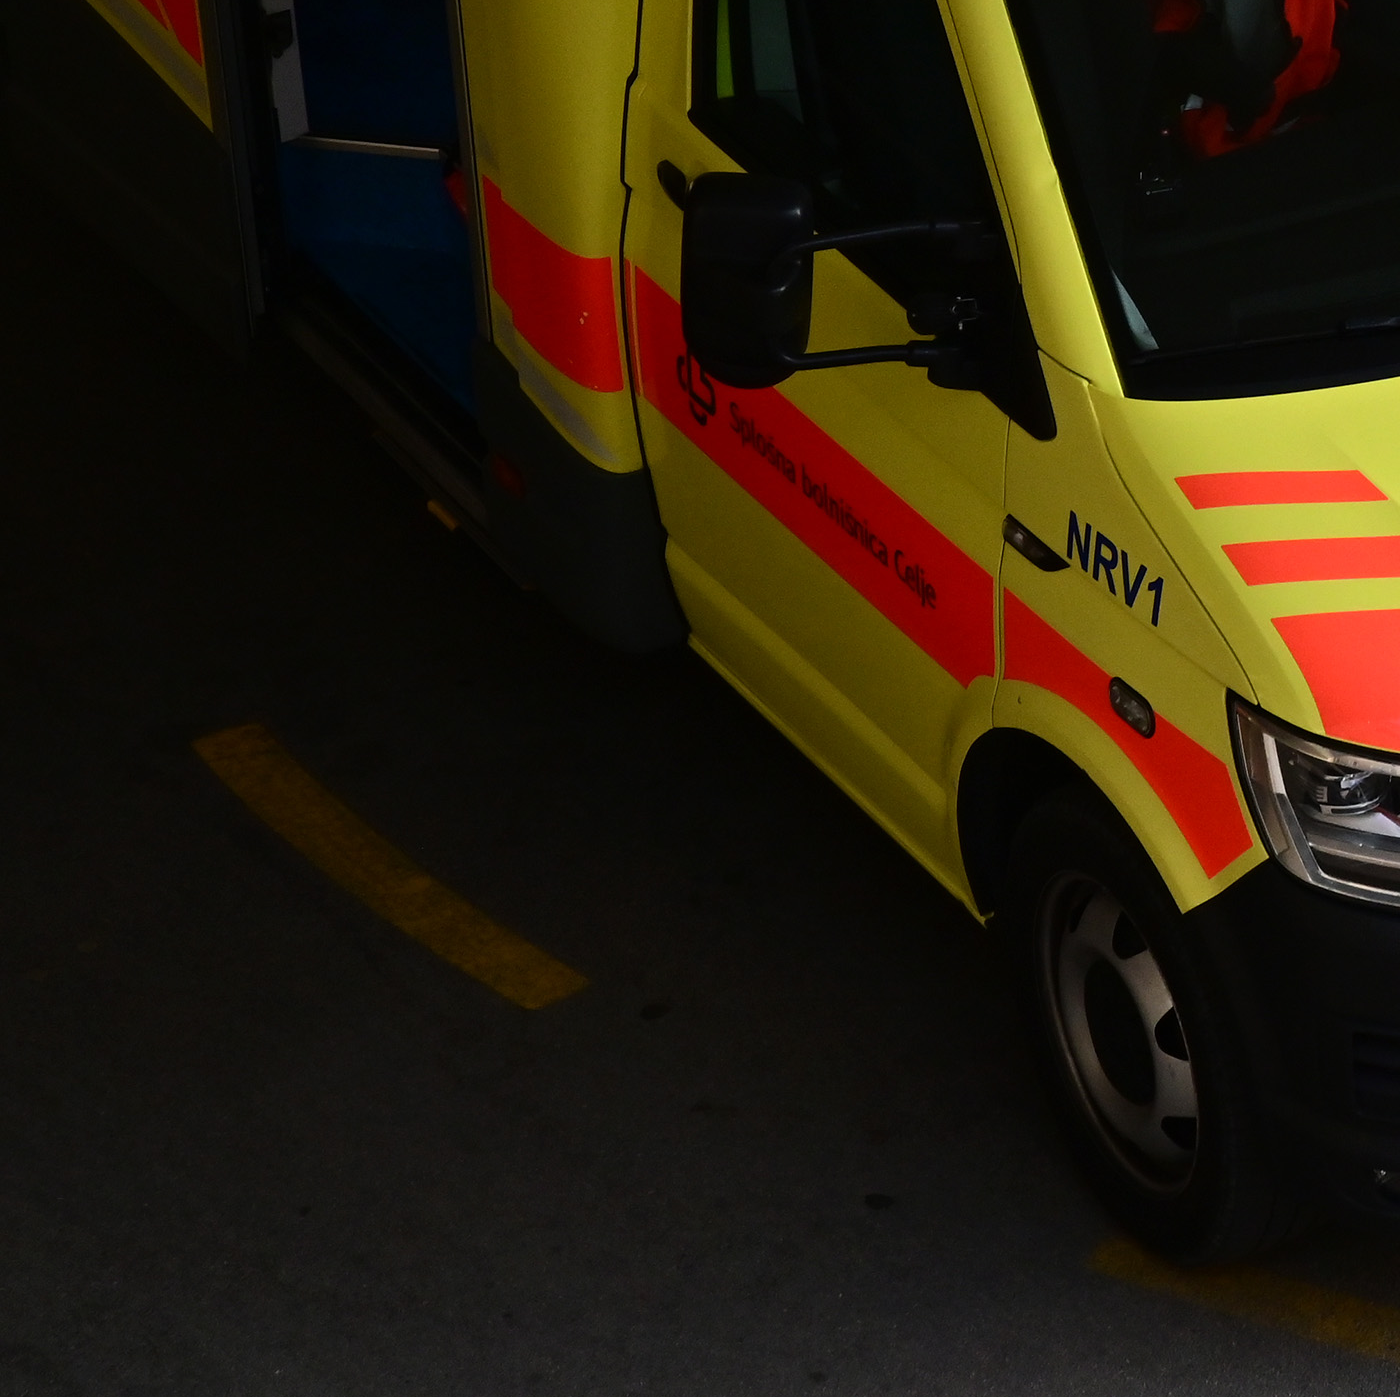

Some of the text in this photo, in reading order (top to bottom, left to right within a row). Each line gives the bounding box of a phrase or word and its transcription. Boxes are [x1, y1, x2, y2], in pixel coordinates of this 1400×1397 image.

[729, 401, 937, 610] Splošna bolnišnica Celje
[1066, 509, 1164, 628] NRV1
